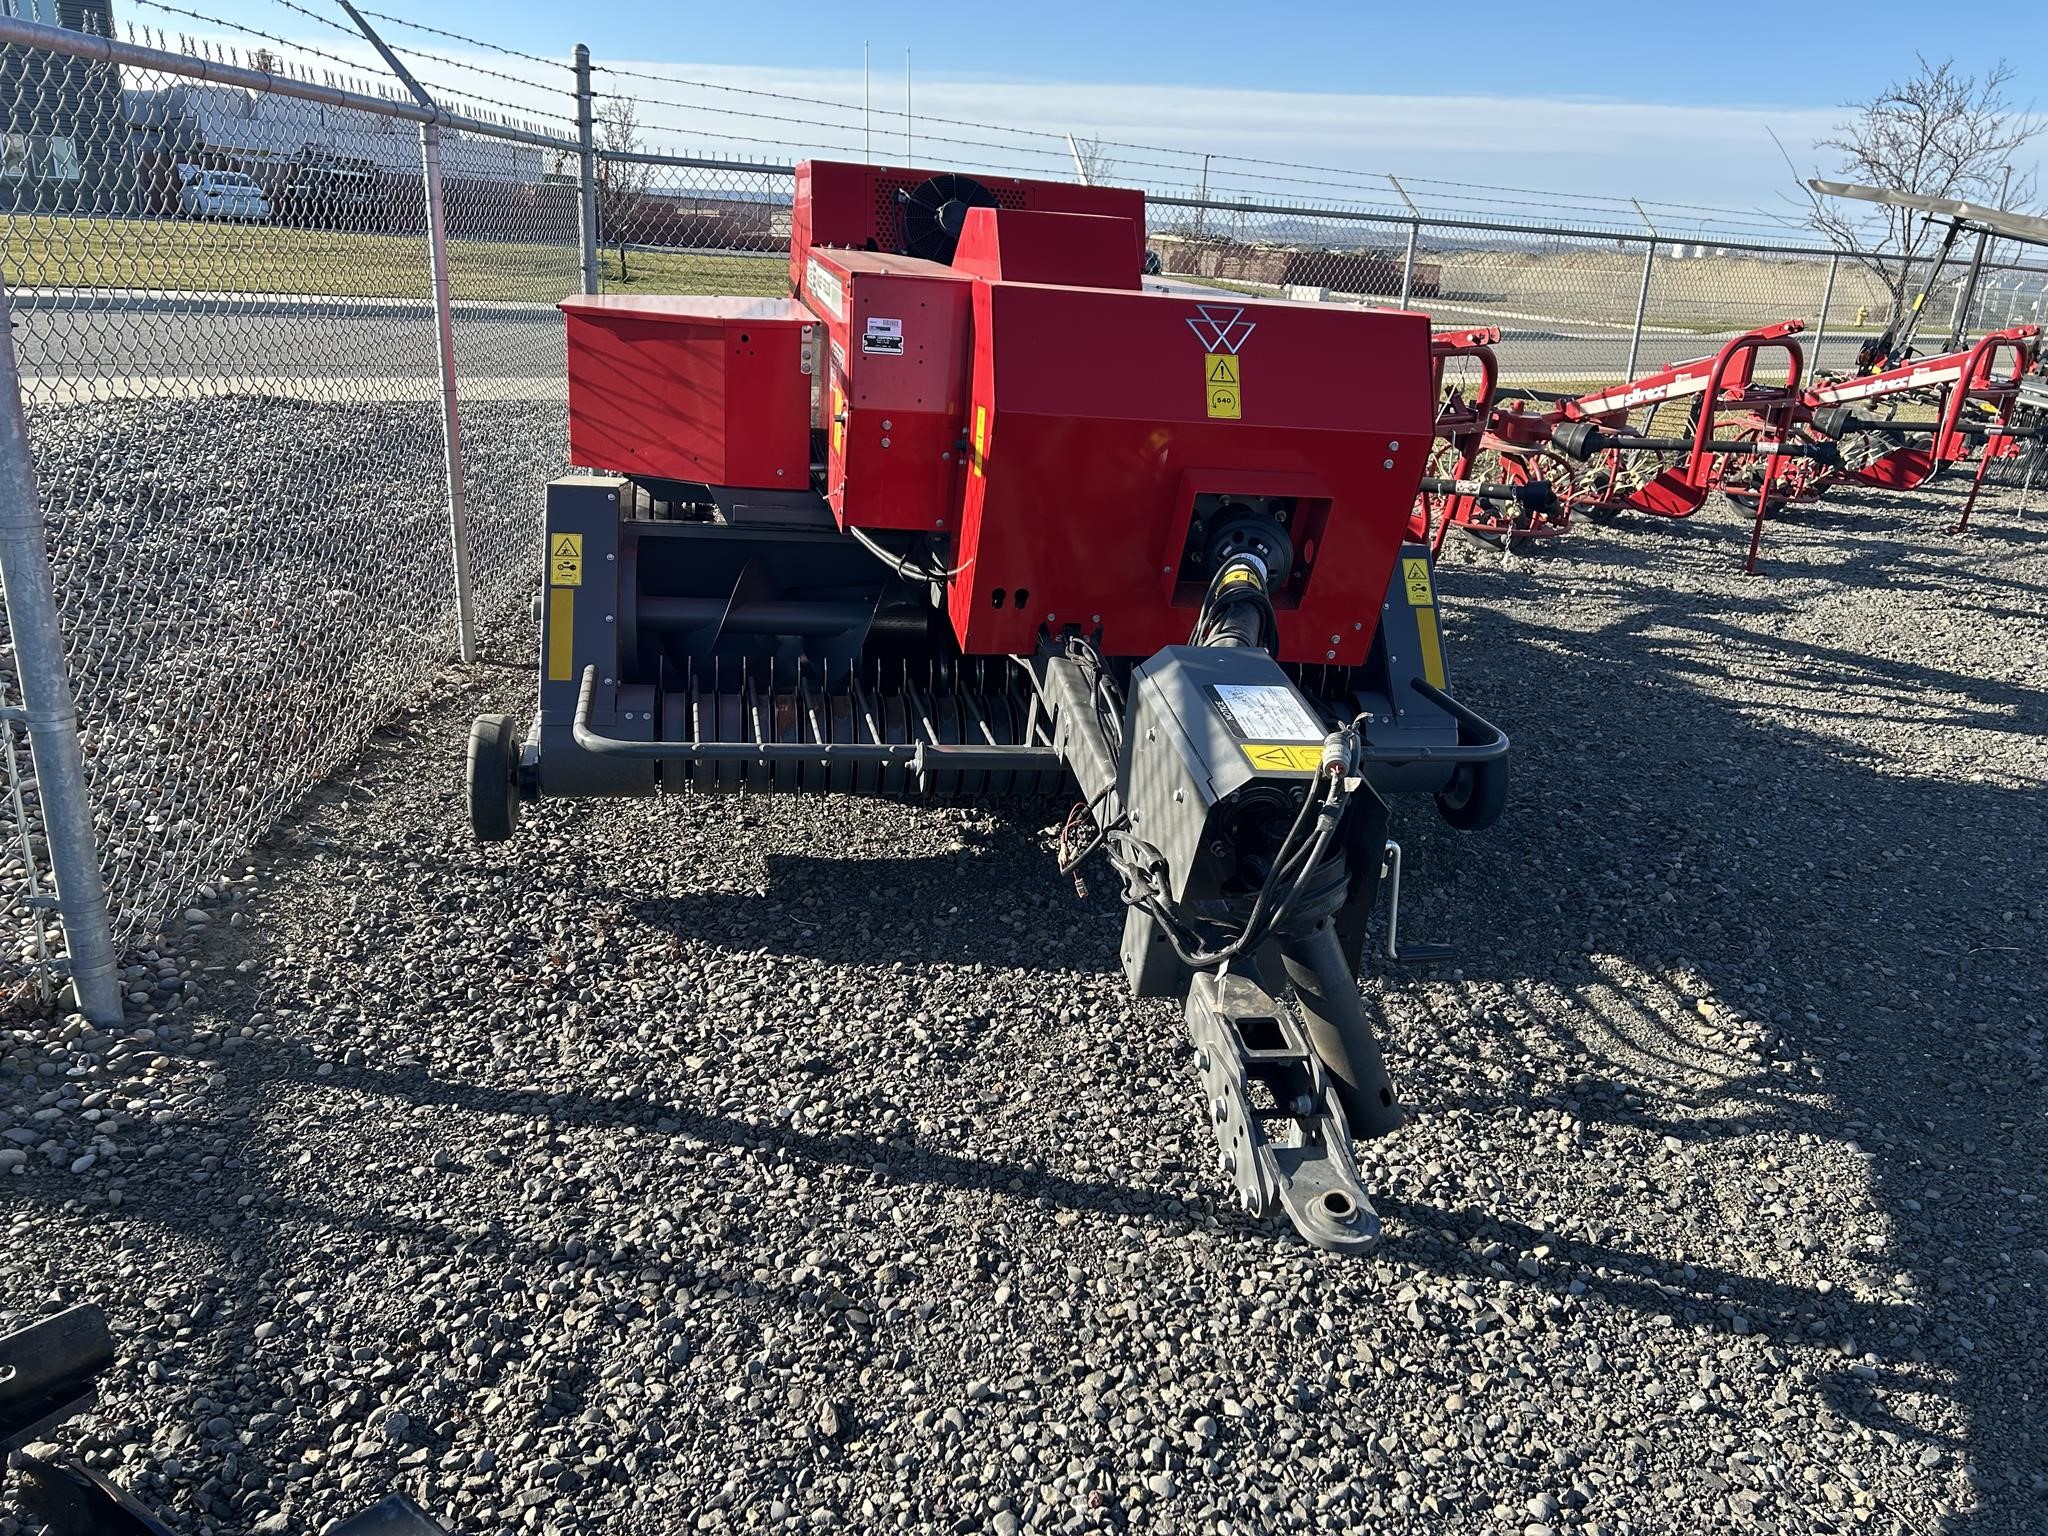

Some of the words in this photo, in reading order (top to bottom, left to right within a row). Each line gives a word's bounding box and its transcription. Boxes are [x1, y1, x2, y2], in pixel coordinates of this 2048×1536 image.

[1625, 385, 1666, 406] sitrex
[1865, 377, 1908, 394] sitrex
[1215, 700, 1234, 721] NOTICE
